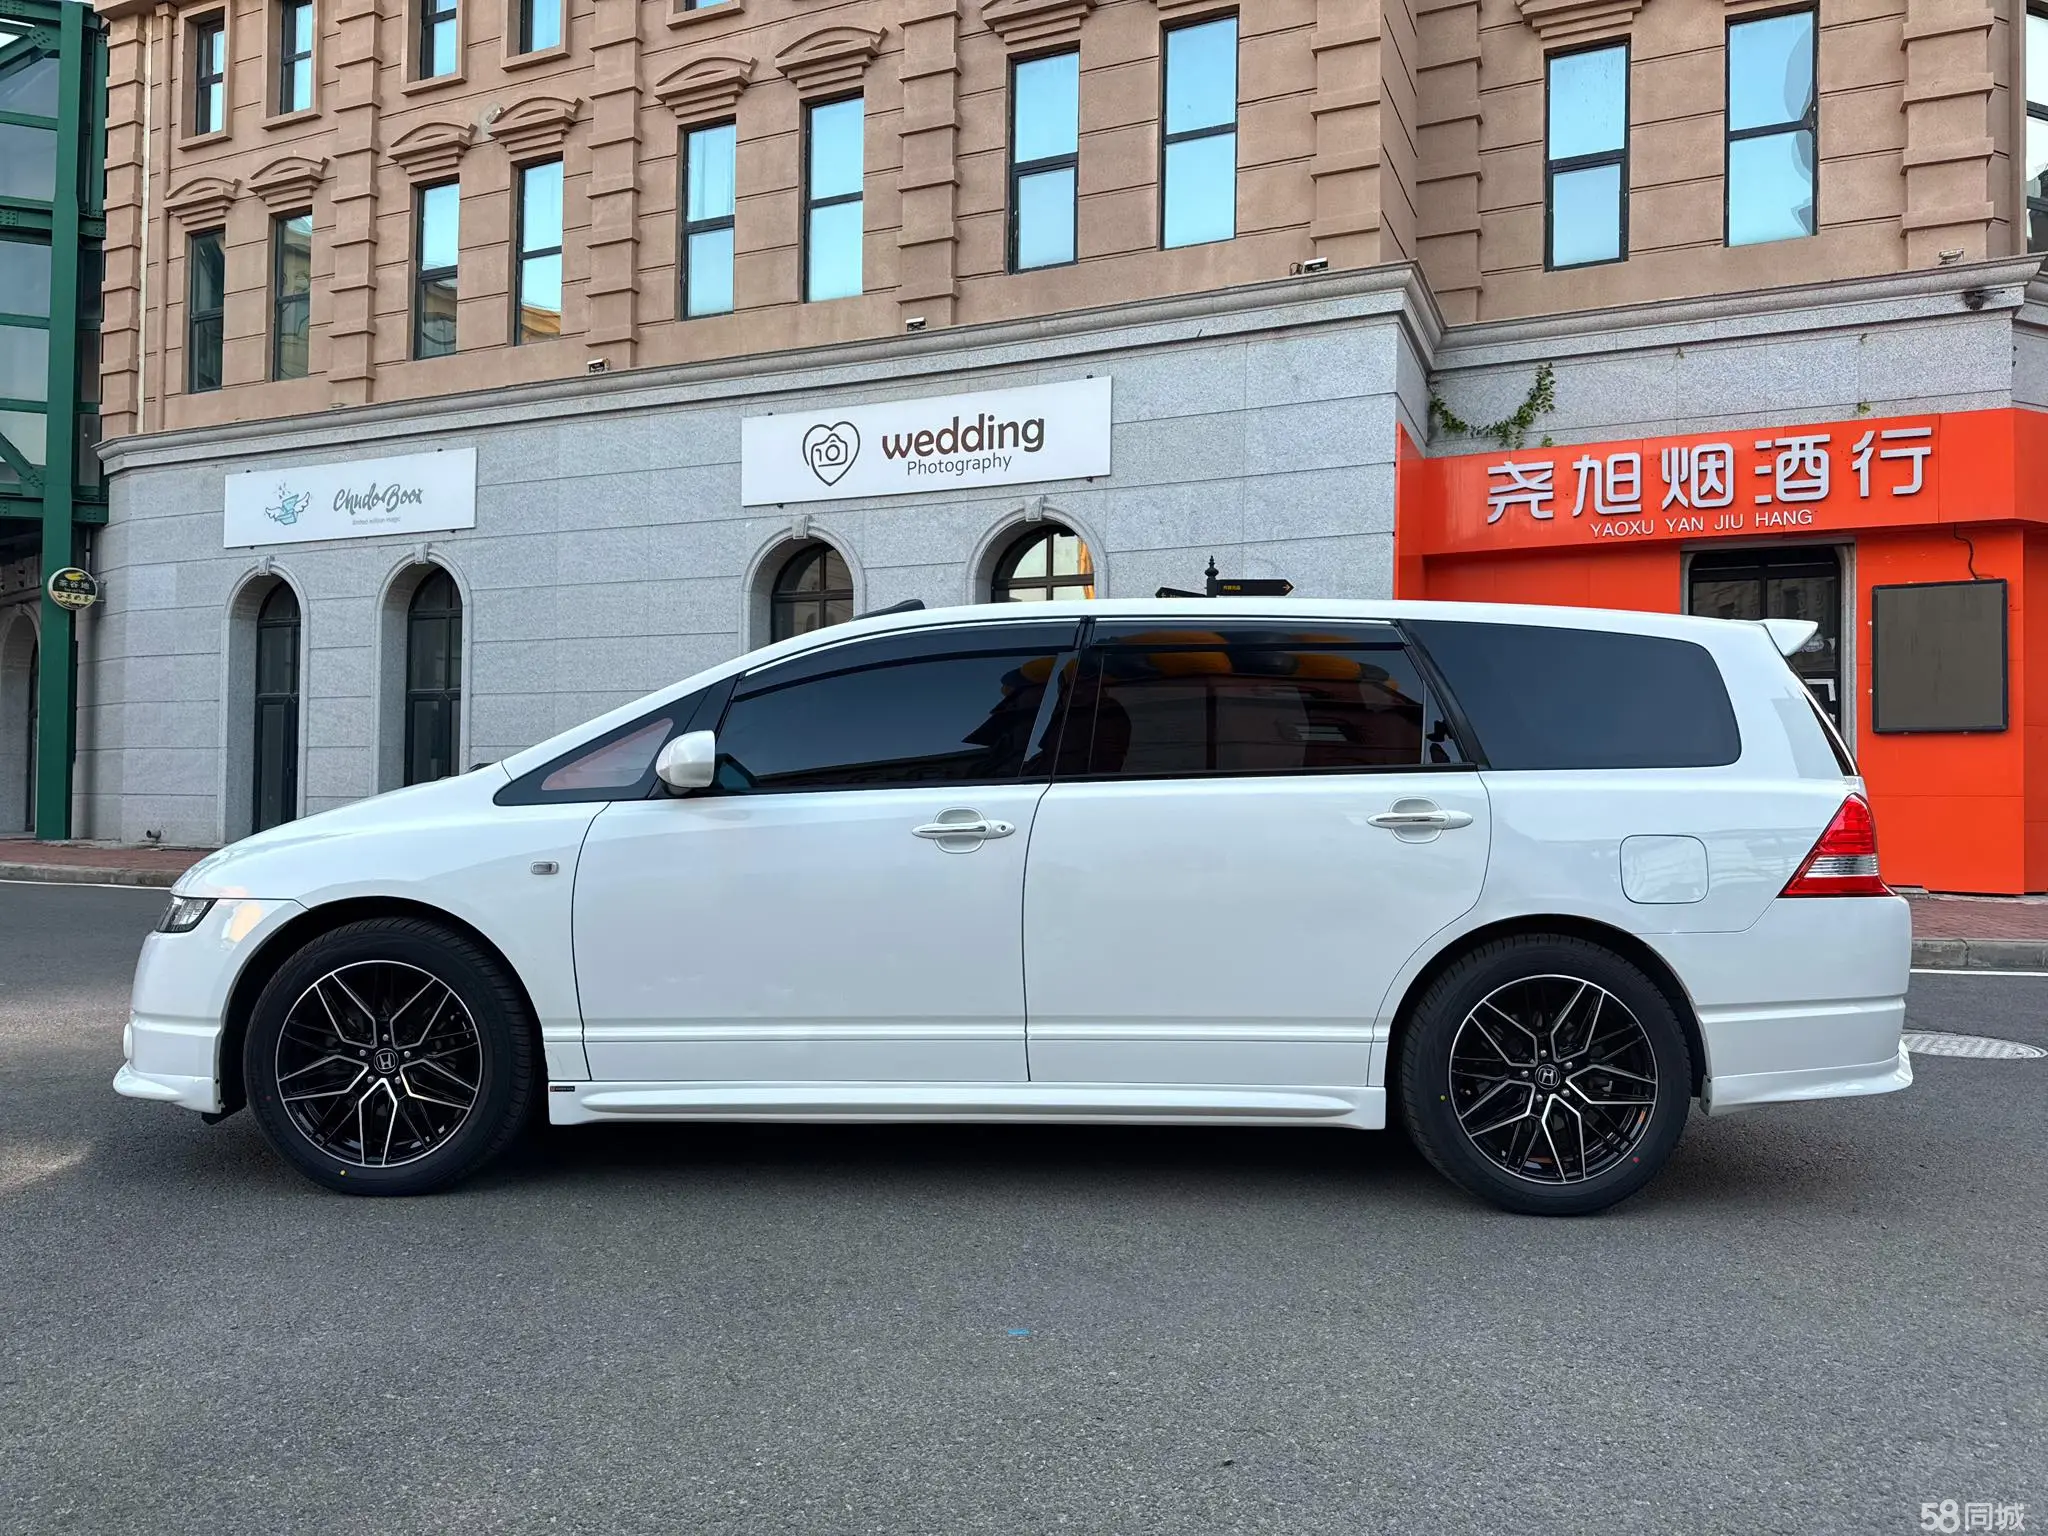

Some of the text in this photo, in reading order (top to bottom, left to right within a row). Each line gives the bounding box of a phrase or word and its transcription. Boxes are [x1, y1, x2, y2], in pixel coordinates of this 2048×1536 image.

[882, 413, 1045, 460] wedding
[907, 452, 1012, 476] Photography
[1487, 427, 1932, 524] 尧旭烟酒行
[1590, 509, 1813, 538] YAOXU YAN JIU HANG
